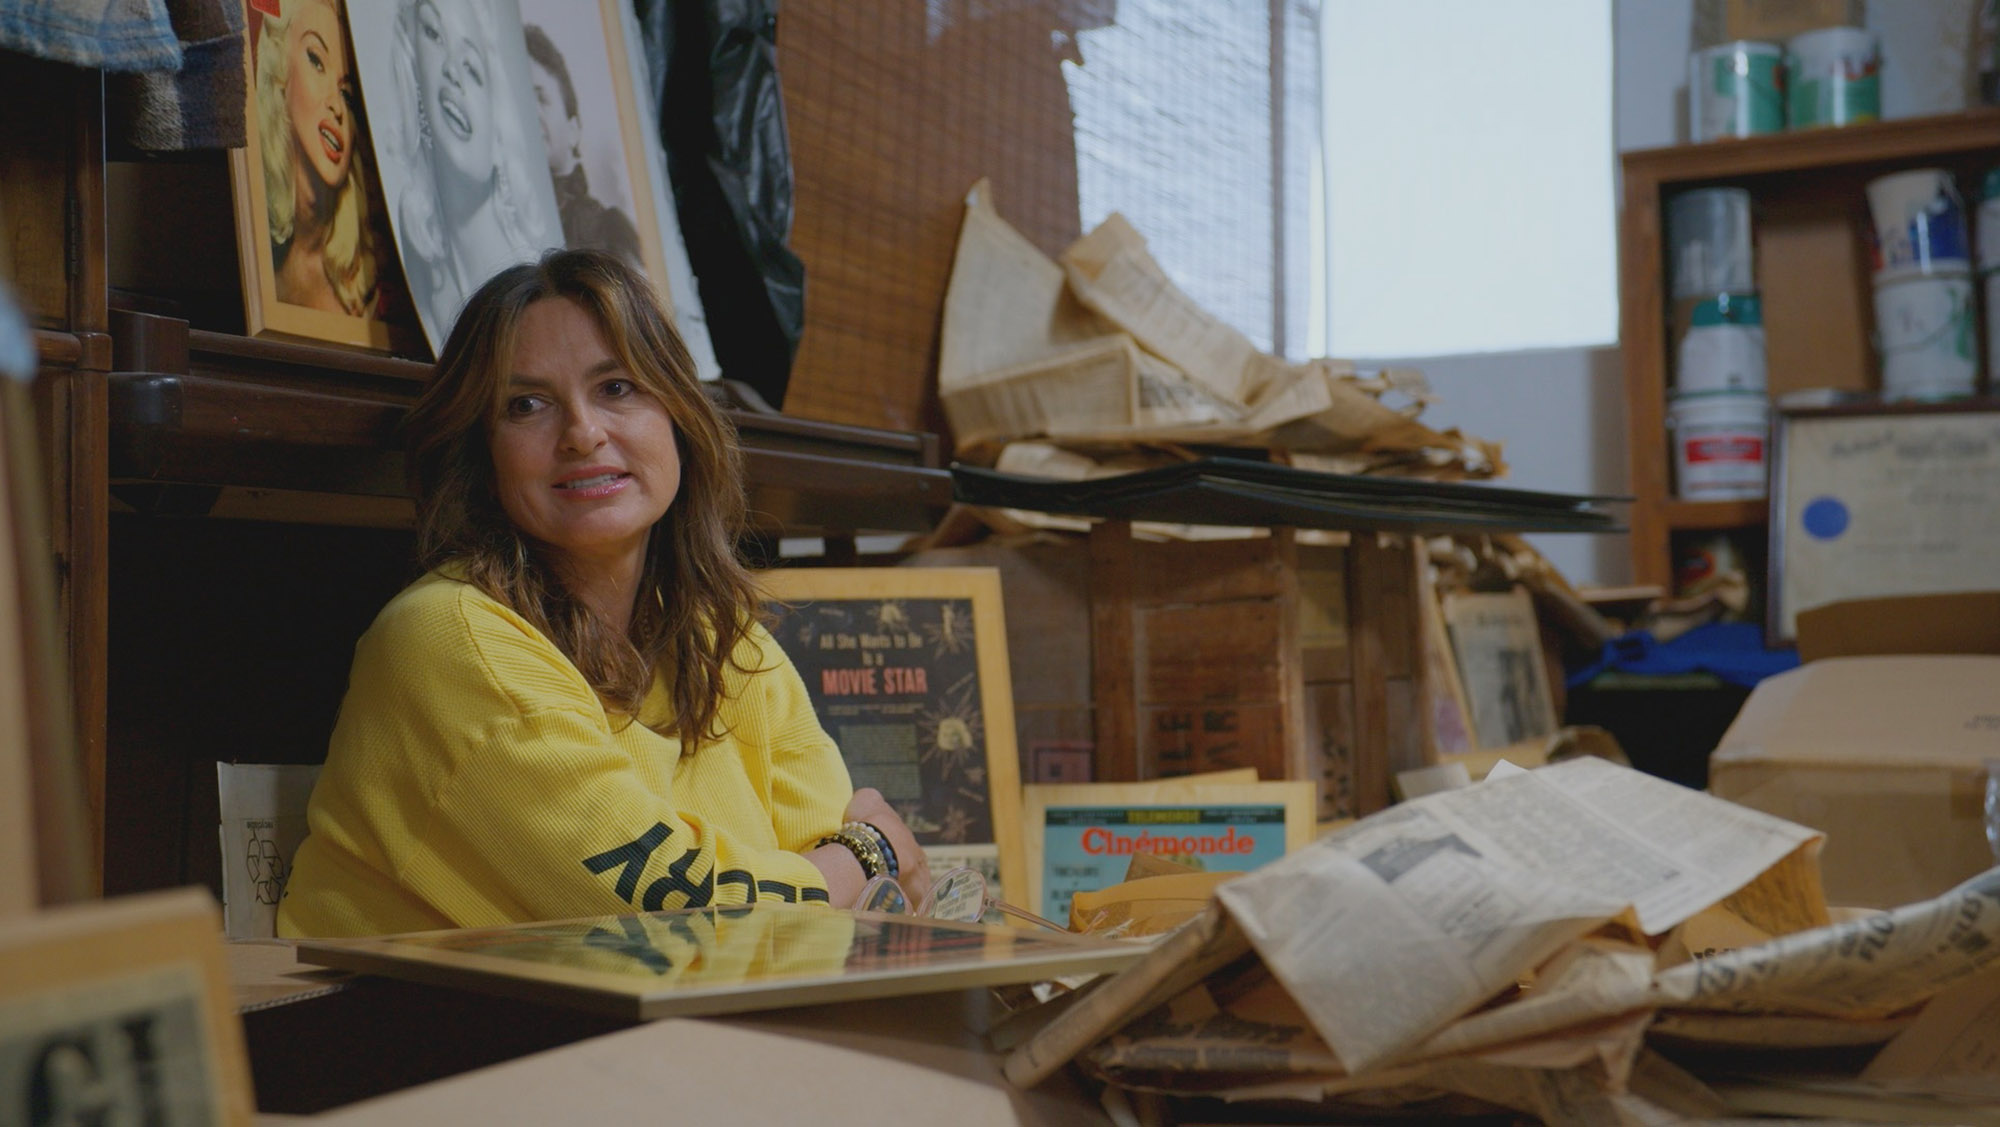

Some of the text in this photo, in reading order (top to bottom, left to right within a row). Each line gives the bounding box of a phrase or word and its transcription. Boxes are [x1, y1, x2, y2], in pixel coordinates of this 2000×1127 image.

[822, 667, 928, 695] MOVIE STAR
[1081, 826, 1255, 856] Cinémonde
